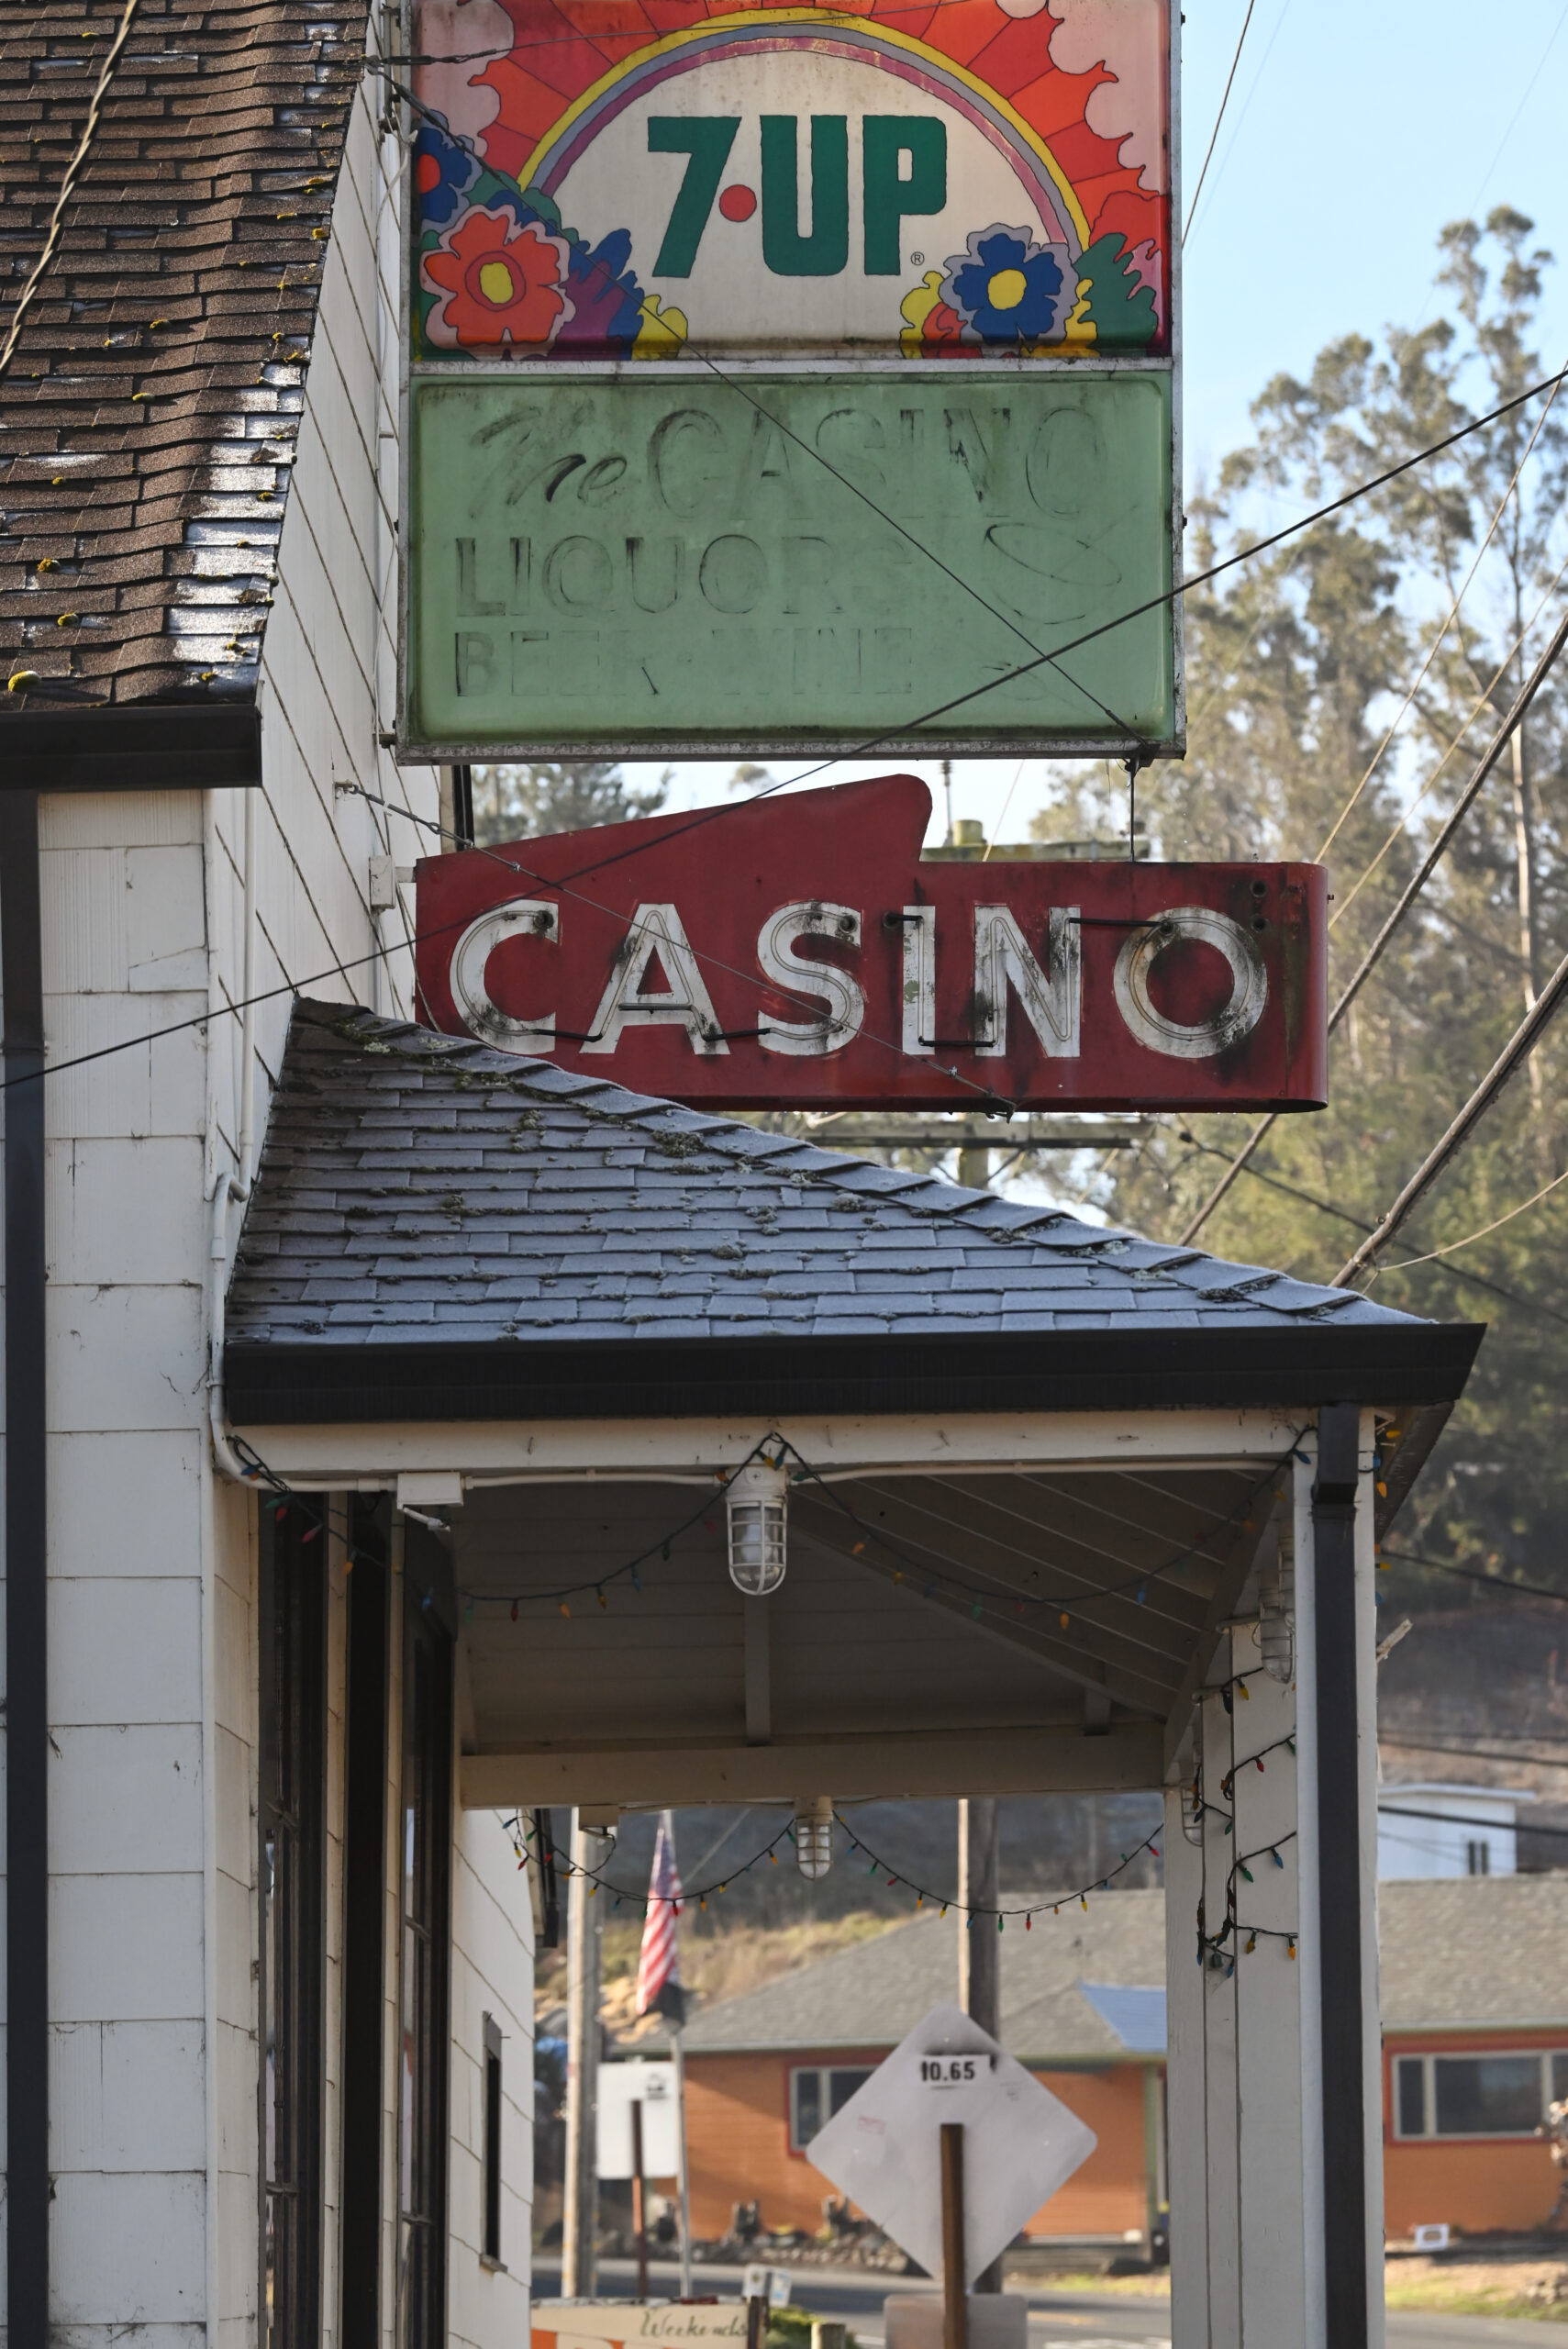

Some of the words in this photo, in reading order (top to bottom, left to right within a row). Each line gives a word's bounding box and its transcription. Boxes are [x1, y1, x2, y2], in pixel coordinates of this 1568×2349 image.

[646, 406, 1109, 521] CASINO
[454, 534, 914, 617] LIQUORS
[449, 900, 1268, 1059] CASINO
[921, 2061, 975, 2082] 10.65
[639, 2309, 748, 2339] Weekends
